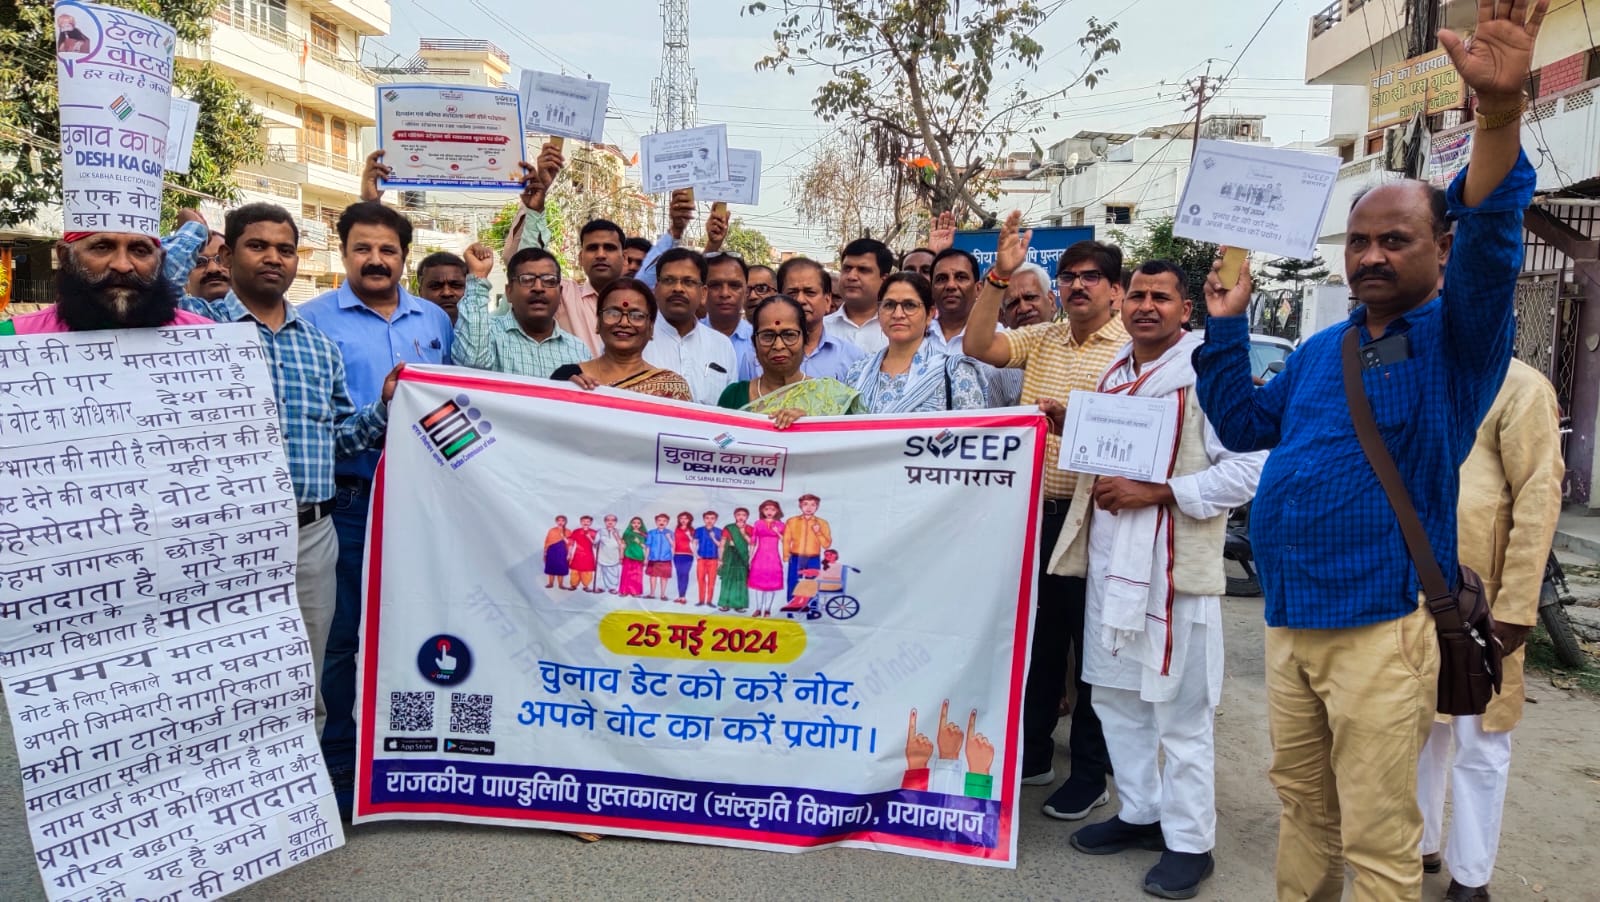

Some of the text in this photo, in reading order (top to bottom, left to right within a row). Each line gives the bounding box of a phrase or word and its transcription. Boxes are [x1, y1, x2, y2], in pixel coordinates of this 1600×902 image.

[105, 13, 161, 48] हैलो
[83, 69, 146, 88] हर वोट है
[1397, 66, 1411, 80] का
[61, 124, 113, 155] चुनाव
[118, 128, 149, 154] का
[76, 150, 115, 168] DESH
[118, 153, 140, 173] KA
[92, 172, 114, 181] SABHA
[115, 174, 146, 184] ELECTION
[84, 189, 121, 210] एक
[127, 187, 158, 211] वोट
[72, 212, 111, 228] बड़ा
[158, 328, 215, 346] युवा
[120, 340, 264, 369] मतदाताओं को
[149, 363, 245, 385] जगाना है
[156, 383, 255, 406] देश को
[7, 404, 41, 434] वोट
[43, 408, 66, 430] का
[70, 396, 137, 427] अधिकार
[136, 397, 278, 427] आगे बढ़ाना है
[146, 423, 281, 456] लोकतंत्र की है
[904, 432, 1021, 461] SWEEP
[5, 439, 146, 479] भारत की नारी है
[167, 451, 275, 477] यही पुकार
[663, 446, 781, 467] चुनाव का पर्व
[683, 462, 776, 477] DESH KA GARV
[158, 467, 295, 506] वोट देना है
[716, 477, 742, 485] ELECTION
[904, 466, 1016, 488] प्रयागराज
[129, 503, 152, 537] है
[250, 499, 294, 515] बार
[236, 521, 291, 544] अपने
[52, 547, 144, 578] जागरूक
[181, 547, 279, 579] सारे काम
[0, 567, 157, 620] मतदाता है
[160, 582, 294, 630] मतदान
[33, 603, 124, 634] भारत के
[0, 613, 160, 667] भाग्य विधाता है
[166, 616, 301, 659] मतदान से
[626, 622, 779, 656] 25 मई 2024
[9, 648, 158, 697] समय
[171, 664, 213, 686] मत
[176, 662, 312, 712] नागरिकता का
[538, 660, 860, 710] चुनाव डेट को करें नोट,
[18, 672, 161, 723] वोट के लिए निकाले
[180, 681, 314, 735] फर्ज निभाओ
[23, 719, 79, 750] अपनी
[186, 706, 316, 766] युवा शक्ति के
[517, 699, 598, 730] अपने
[606, 703, 658, 738] वोट
[667, 713, 712, 742] का
[723, 711, 776, 745] करें
[21, 717, 179, 784] कभी ना टाले
[203, 734, 304, 780] तीन है काम
[27, 744, 184, 811] मतदाता सूची में
[195, 752, 322, 809] शिक्षा सेवा और
[40, 776, 185, 838] नाम दर्ज कराए
[208, 773, 317, 826] मतदान
[386, 765, 985, 837] राजकीय पाण्डुलिपि पुस्तकालय (संस्कृति विभाग), प्रयागराज
[36, 808, 159, 870] प्रयागराज
[54, 824, 199, 888] गौरव बढ़ाए
